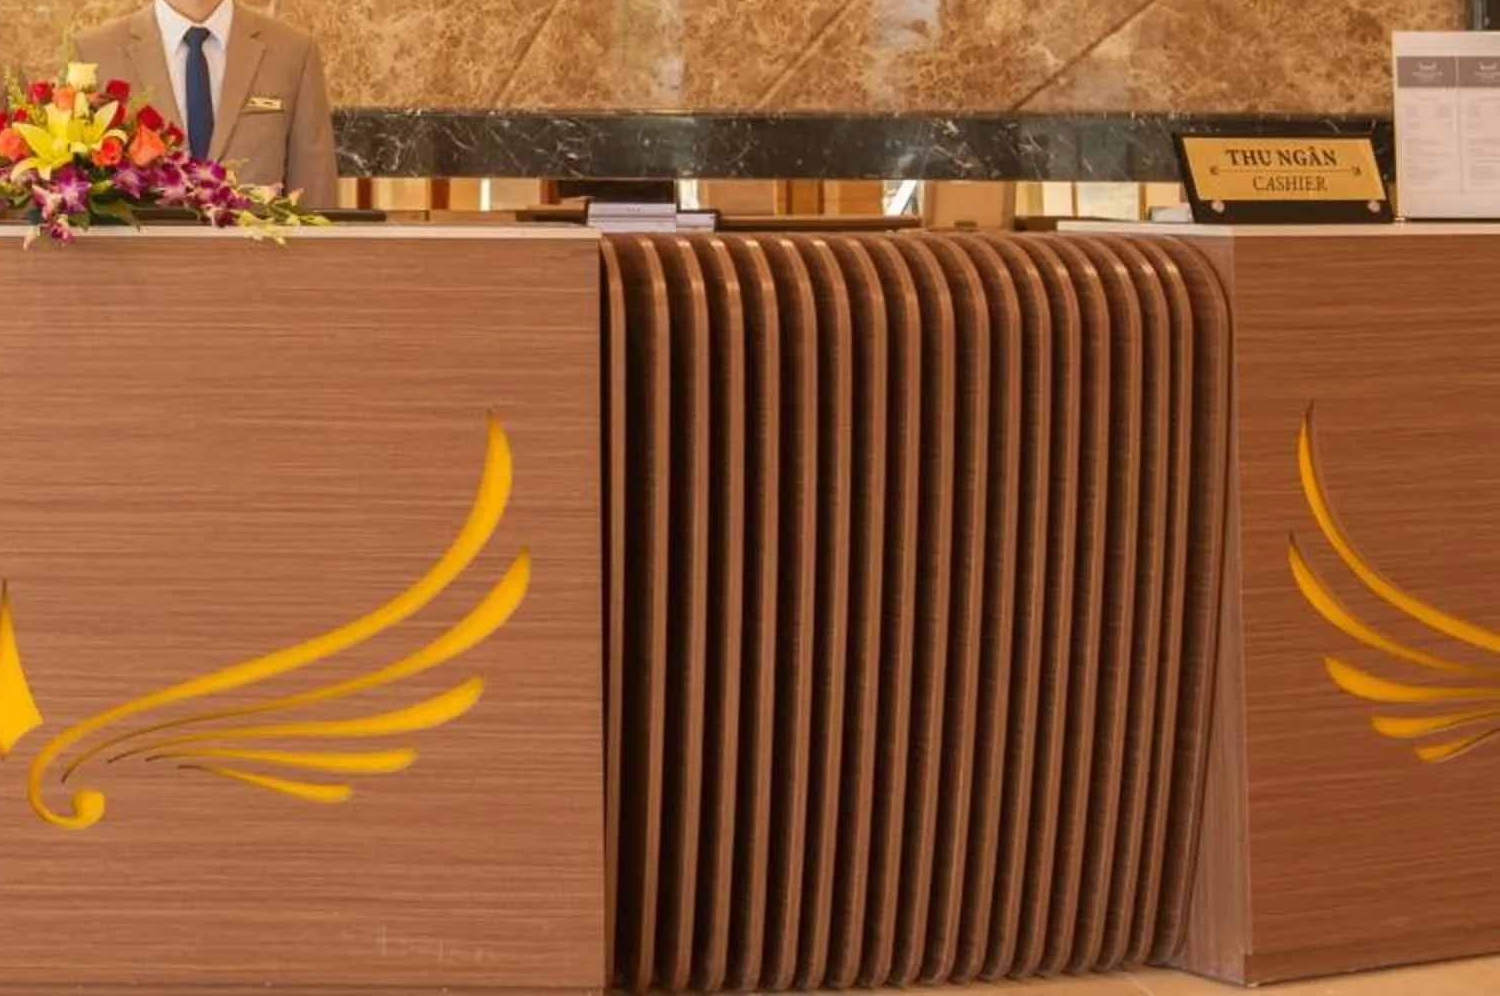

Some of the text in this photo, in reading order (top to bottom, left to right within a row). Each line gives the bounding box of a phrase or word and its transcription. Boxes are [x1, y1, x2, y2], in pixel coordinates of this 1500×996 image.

[1225, 146, 1338, 167] THU NGÂN
[1252, 175, 1329, 193] CASHIER
